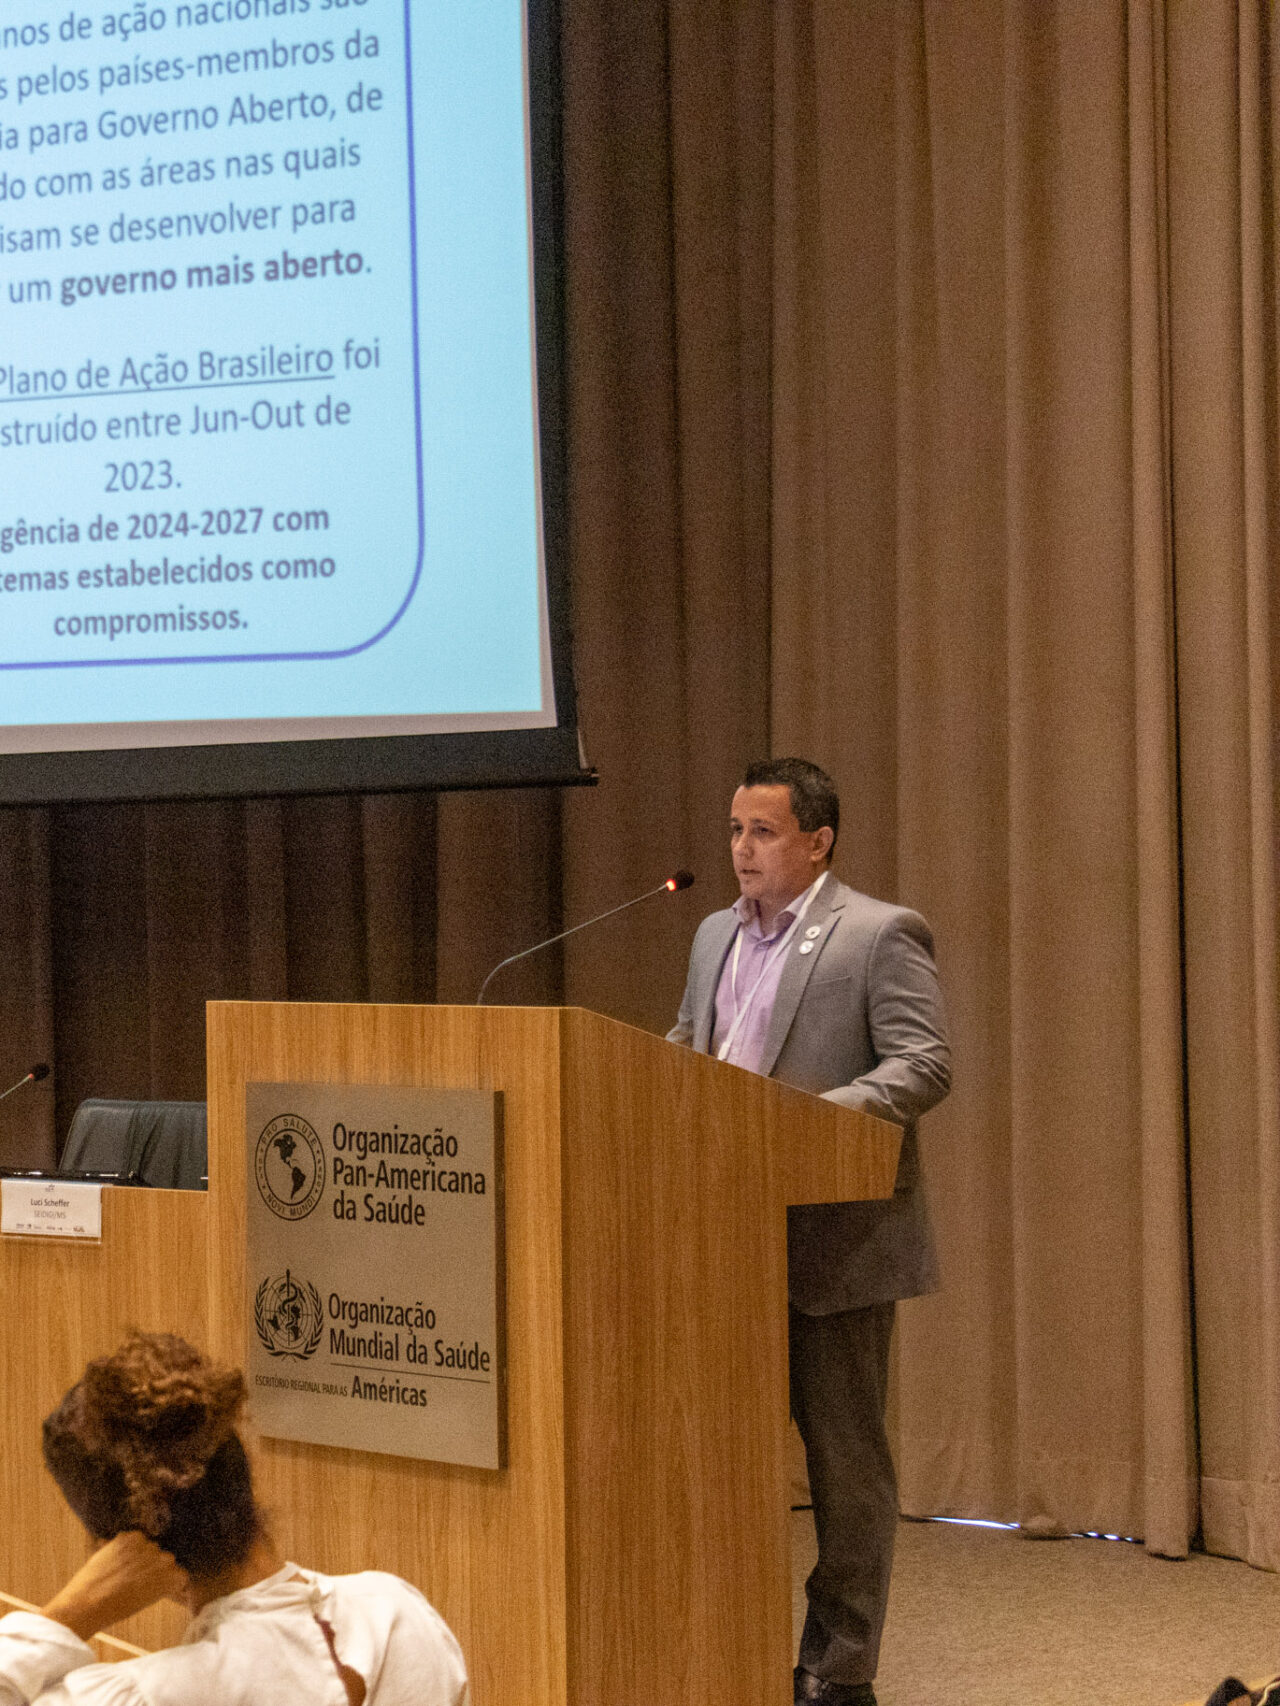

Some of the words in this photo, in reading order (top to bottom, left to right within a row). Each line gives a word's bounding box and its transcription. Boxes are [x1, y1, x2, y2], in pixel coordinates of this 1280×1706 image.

[17, 63, 90, 105] pelos
[98, 38, 335, 95] países-membros
[344, 28, 380, 60] da
[28, 119, 89, 154] para
[97, 105, 219, 140] Governo
[227, 91, 336, 127] Aberto,
[346, 81, 383, 114] de
[34, 171, 93, 198] com
[101, 167, 131, 191] as
[139, 157, 216, 188] áreas
[225, 152, 274, 178] nas
[282, 137, 361, 179] quais
[70, 223, 100, 248] se
[109, 201, 282, 244] desenvolver
[291, 198, 356, 233] para
[8, 278, 52, 304] um
[59, 268, 178, 307] governo
[186, 254, 256, 289] mais
[263, 248, 372, 282] aberto.
[75, 358, 110, 390] de
[119, 352, 189, 387] Ação
[198, 343, 334, 381] Brasileiro
[343, 337, 380, 370] foi
[106, 410, 182, 440] entre
[190, 400, 305, 435] Jun-Out
[314, 394, 351, 427] de
[104, 459, 182, 493] 2023.
[87, 513, 120, 542] de
[127, 506, 264, 540] 2024-2027
[272, 509, 330, 532] com
[76, 554, 253, 589] estabelecidos
[261, 556, 337, 581] como
[333, 1123, 458, 1166] Organização
[333, 1157, 486, 1194] Pan-Americana
[44, 1199, 70, 1207] Scheffer
[333, 1190, 356, 1220] da
[364, 1194, 425, 1226] Saúde
[328, 1293, 436, 1334] Organização
[330, 1328, 399, 1361] Mundial
[406, 1335, 428, 1364] da
[435, 1340, 490, 1372] Saúde
[351, 1376, 427, 1406] Américas
